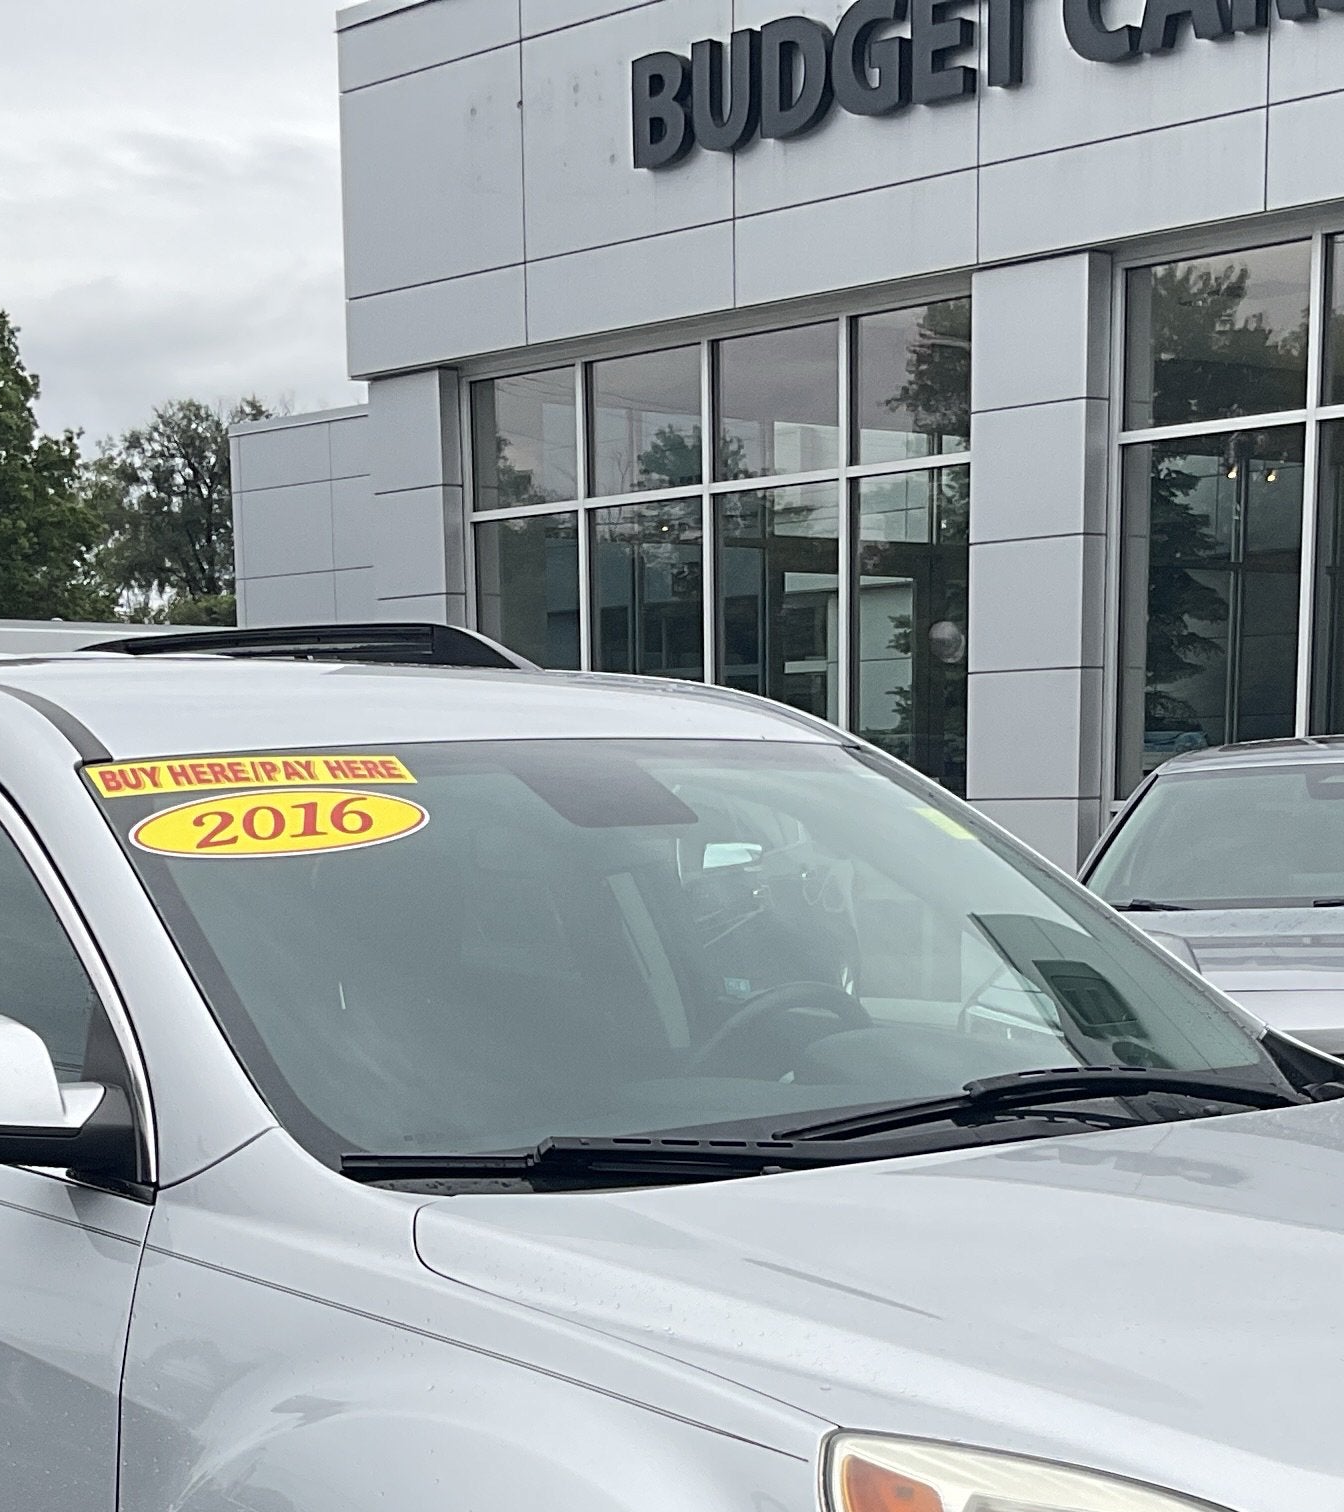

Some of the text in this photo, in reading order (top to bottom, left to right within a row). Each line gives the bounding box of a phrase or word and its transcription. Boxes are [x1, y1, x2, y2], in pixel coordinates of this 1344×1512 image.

[632, 0, 1024, 169] BUDGET
[98, 759, 406, 792] BUY HERE/PAY HERE
[192, 797, 374, 849] 2016
